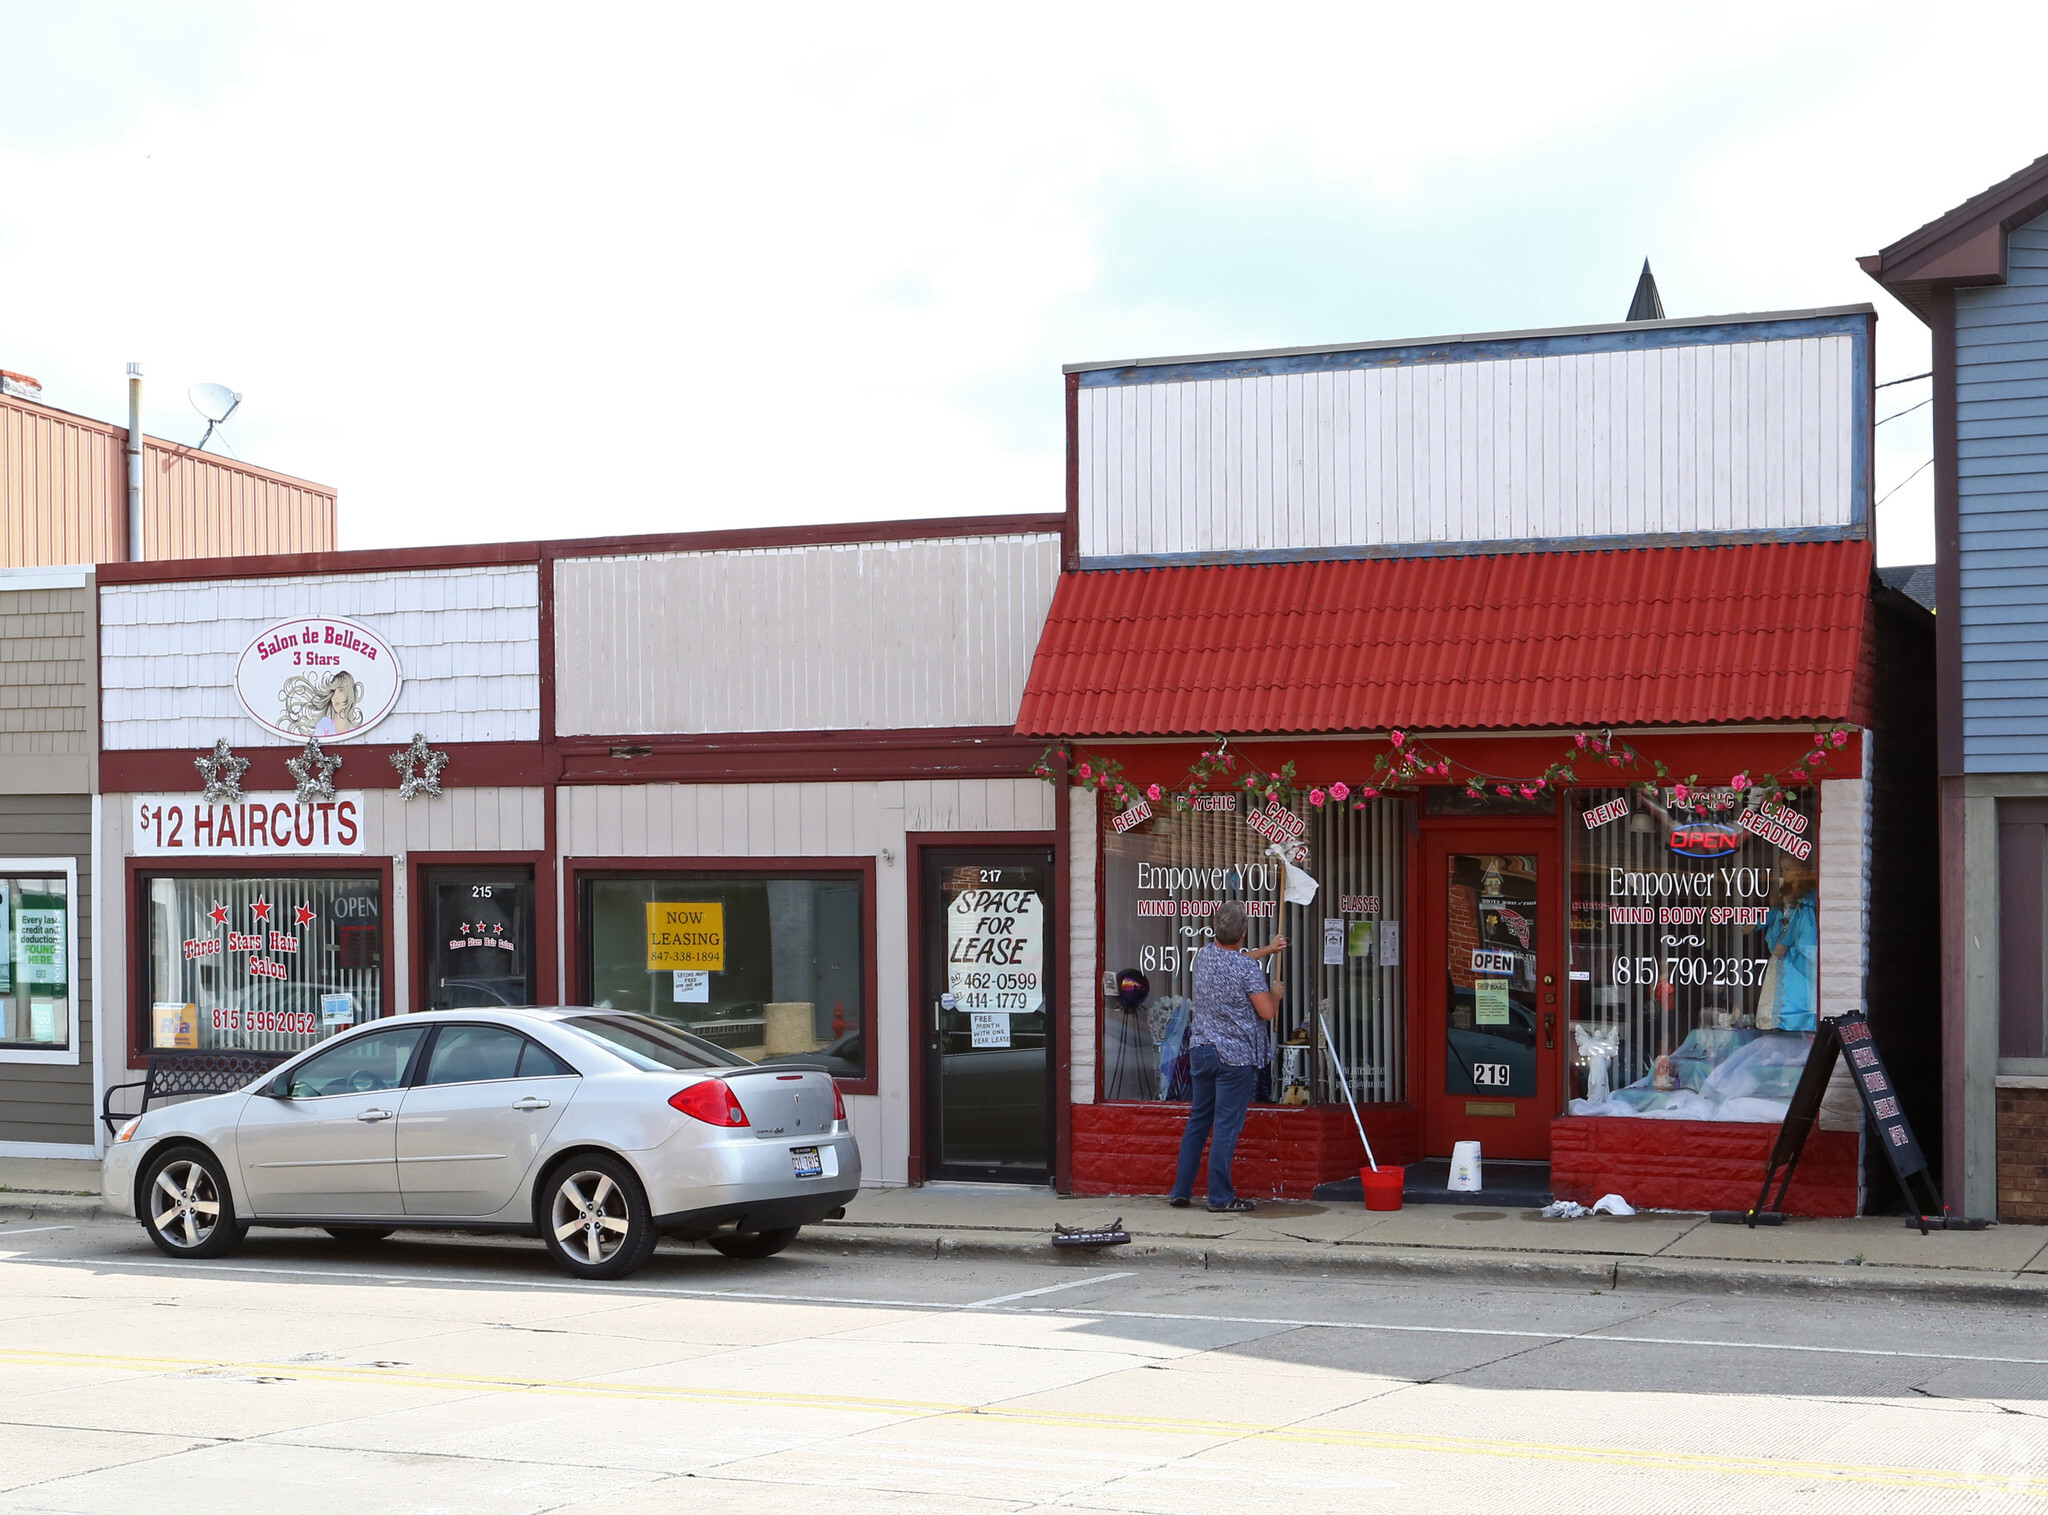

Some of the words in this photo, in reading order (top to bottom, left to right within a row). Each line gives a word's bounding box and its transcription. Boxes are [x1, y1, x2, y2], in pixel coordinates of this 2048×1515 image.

[257, 634, 298, 661] Salon
[302, 626, 319, 644] de
[324, 626, 378, 661] Belleza
[293, 651, 301, 666] 3
[306, 651, 340, 666] Stars
[1176, 795, 1236, 811] PYCHIC
[1112, 801, 1152, 834] REIKI
[1265, 801, 1305, 837] CARD
[1583, 797, 1629, 830] REIKI
[1760, 800, 1808, 834] CARD
[140, 802, 184, 847] $12
[194, 800, 358, 847] HAIRCUTS
[1246, 808, 1309, 863] READG
[1670, 832, 1736, 849] OPEN
[1737, 808, 1812, 861] READING
[979, 869, 1002, 883] 217
[1137, 862, 1229, 897] Empower
[1234, 863, 1279, 891] YOU
[1609, 867, 1715, 904] Empower
[1720, 867, 1771, 898] YOU
[472, 885, 492, 898] 215
[334, 897, 379, 919] OPEN
[956, 890, 1036, 914] SPACE
[1137, 900, 1176, 917] MIND
[1180, 900, 1222, 917] BODY
[1341, 895, 1380, 913] CLASSES
[22, 915, 43, 926] Every
[666, 911, 704, 925] NOW
[975, 916, 1015, 935] FOR
[1609, 907, 1655, 925] MIND
[1659, 907, 1706, 925] BODY
[1710, 907, 1769, 925] SPIRIT
[22, 926, 43, 935] credit
[651, 932, 720, 946] LEASING
[25, 945, 57, 955] FOUND
[184, 938, 221, 960] Three
[228, 931, 262, 952] Stars
[269, 931, 298, 953] Hair
[950, 937, 1028, 966] LEASE
[651, 951, 720, 962] 847-338-1894
[1139, 944, 1180, 978] (815)
[1473, 952, 1512, 971] OPEN
[250, 956, 287, 980] Salon
[1612, 955, 1659, 991] (815)
[1666, 957, 1768, 987] 790-2337
[964, 972, 1037, 990] 462-0599
[966, 992, 1027, 1009] 414-1779
[212, 1009, 239, 1030] 815
[246, 1011, 315, 1034] 5962052
[974, 1015, 993, 1023] FREE
[976, 1022, 1000, 1030] MONTH
[991, 1036, 1010, 1044] LEASE
[1475, 1064, 1508, 1085] 219
